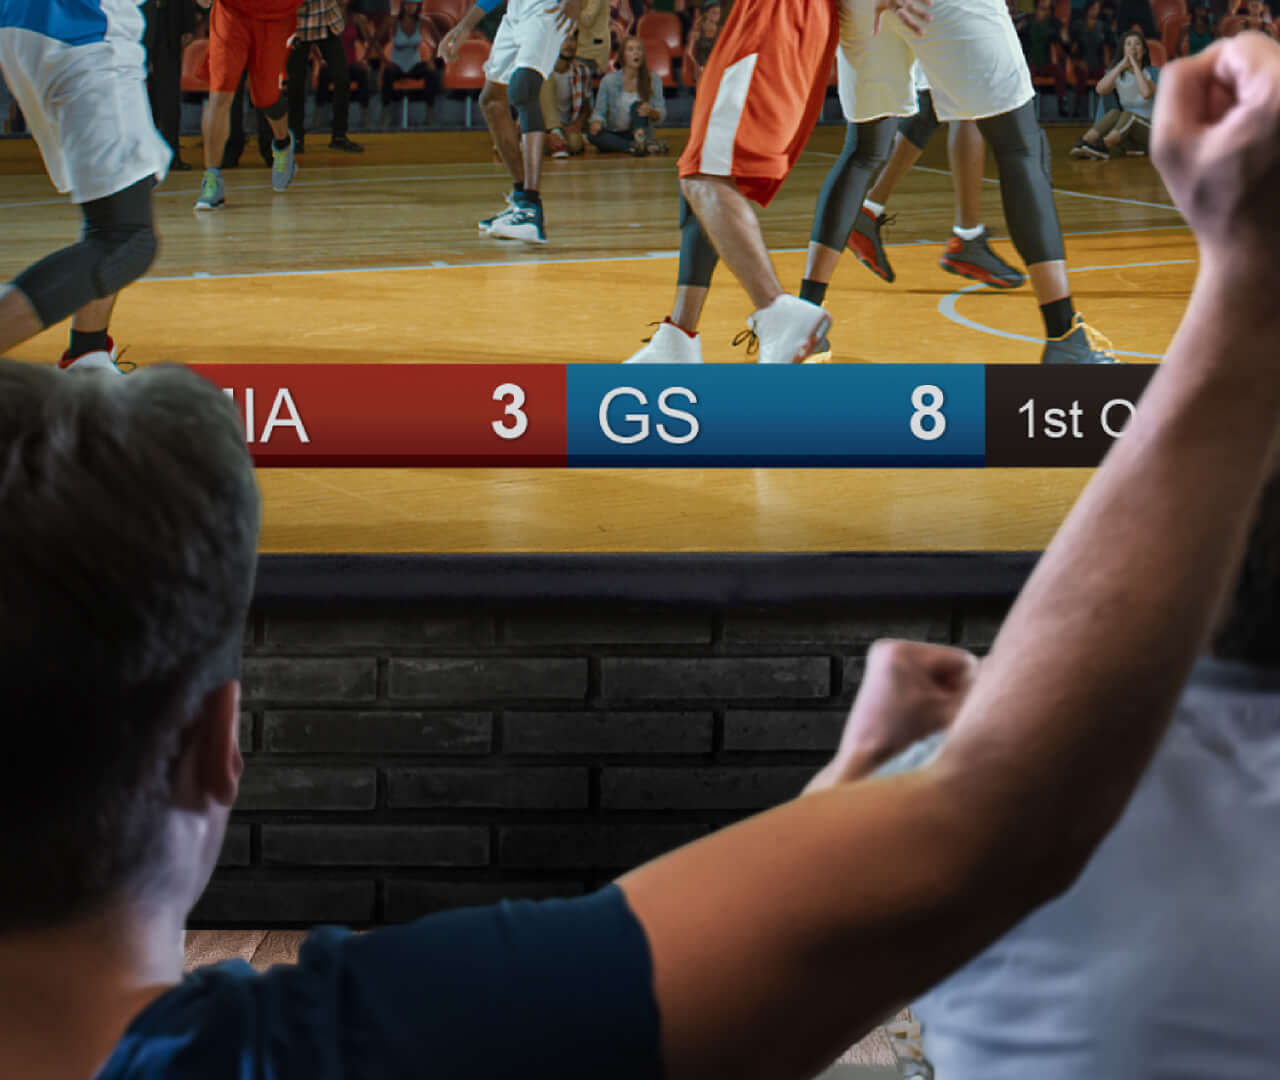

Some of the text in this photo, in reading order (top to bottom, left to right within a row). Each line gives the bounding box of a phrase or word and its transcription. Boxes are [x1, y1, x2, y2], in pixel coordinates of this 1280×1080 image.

[222, 383, 528, 443] IA 3
[598, 384, 946, 445] GS 8
[1018, 398, 1084, 438] 1st
